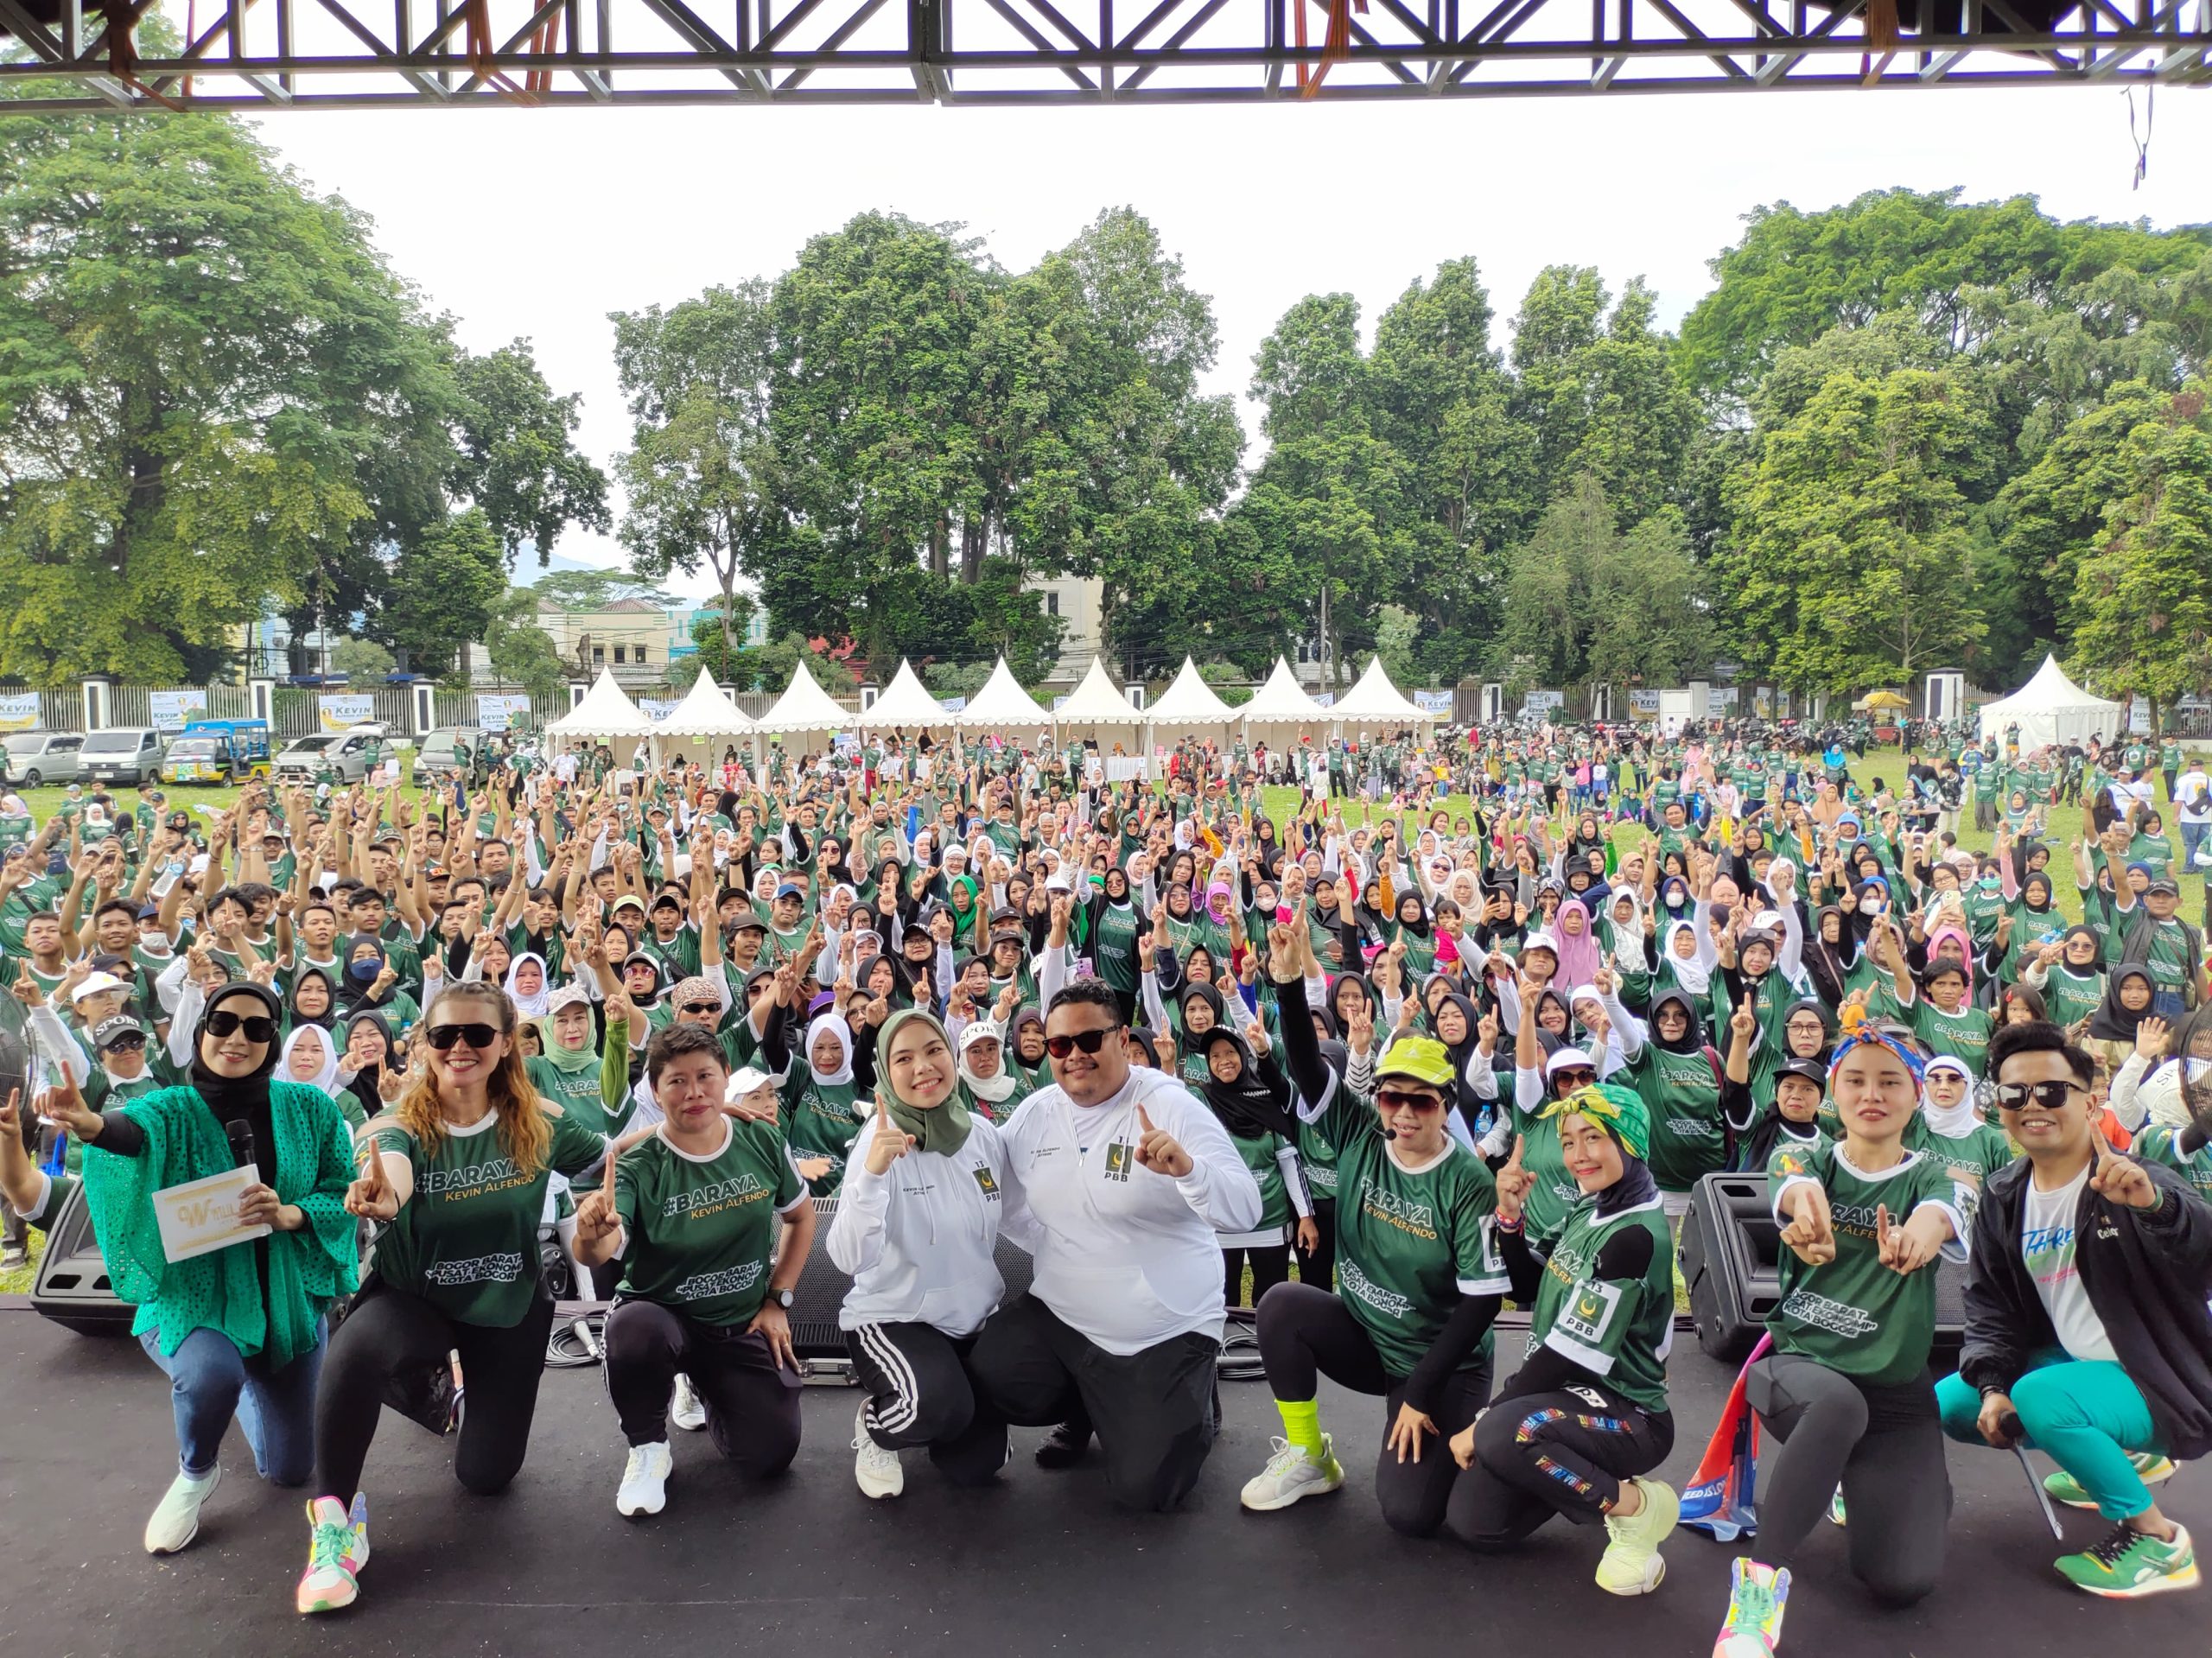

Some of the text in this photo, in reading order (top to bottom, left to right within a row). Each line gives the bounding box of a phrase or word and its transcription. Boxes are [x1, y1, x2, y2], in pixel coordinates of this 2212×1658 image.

[975, 1160, 985, 1169] 13
[1104, 1172, 1128, 1183] PBB
[445, 1174, 536, 1203] KEVIN ALFENDO
[663, 1173, 760, 1217] #BARAYA
[690, 1189, 770, 1220] KEVIN ALFENDO
[1389, 1217, 1439, 1241] ALFENDO
[435, 1258, 480, 1271] BOGOR
[437, 1270, 517, 1285] KOTA BOGOR
[718, 1278, 753, 1295] BOGOR
[1591, 1281, 1604, 1293] 13
[1566, 1318, 1594, 1337] PBB
[1783, 1304, 1859, 1338] KOTA BOGOR
[1516, 1416, 1537, 1443] ZUMBA
